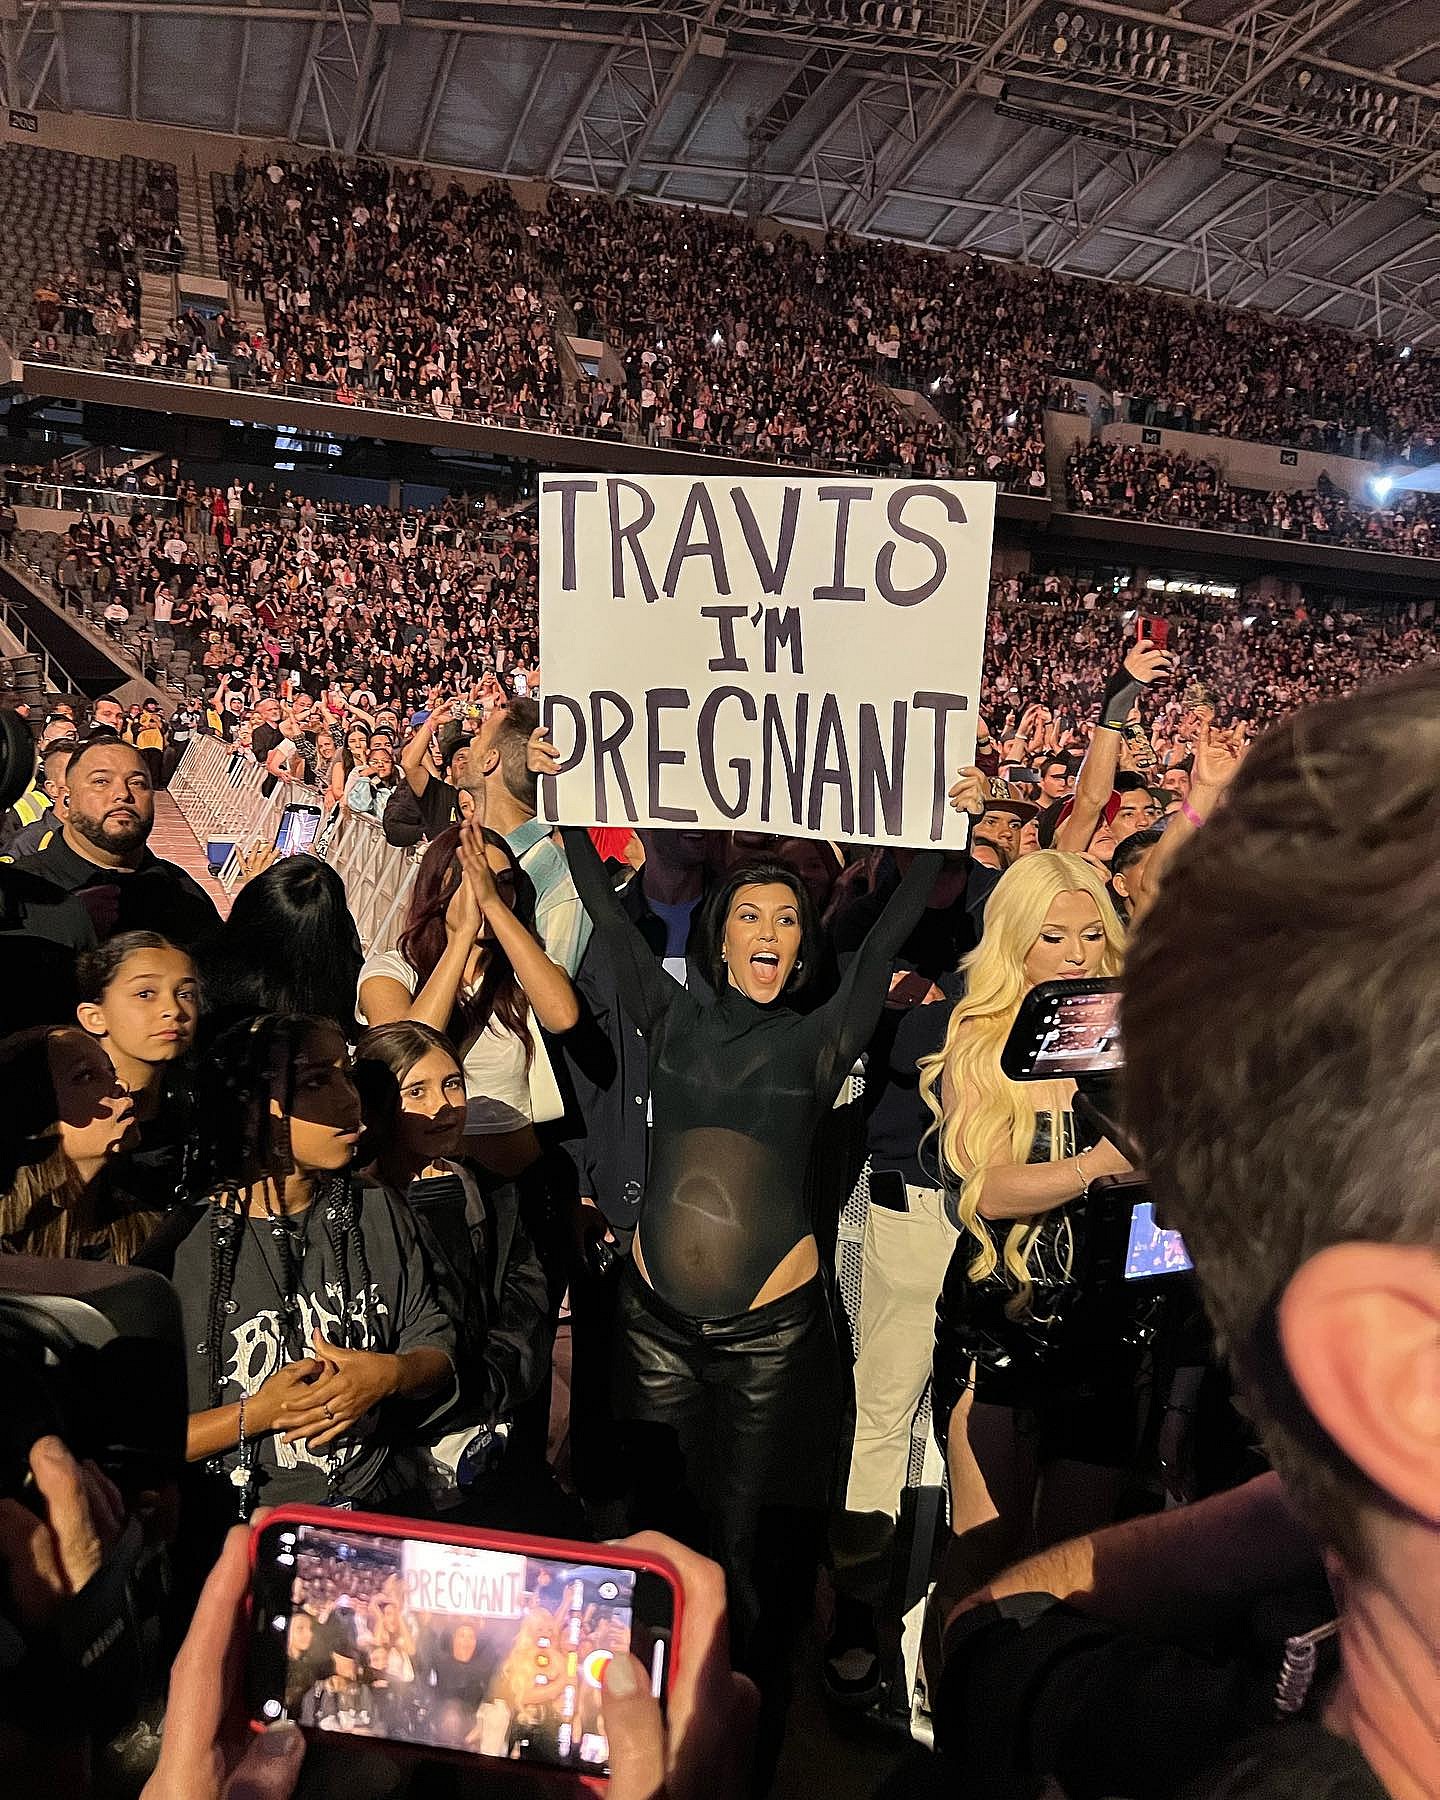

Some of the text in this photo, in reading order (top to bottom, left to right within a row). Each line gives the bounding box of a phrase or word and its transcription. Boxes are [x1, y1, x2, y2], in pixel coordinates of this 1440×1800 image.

[543, 478, 967, 606] TRAVIS
[701, 602, 803, 674] I'M
[542, 686, 968, 841] PREGNANT
[406, 1569, 521, 1614] PREGNANT
